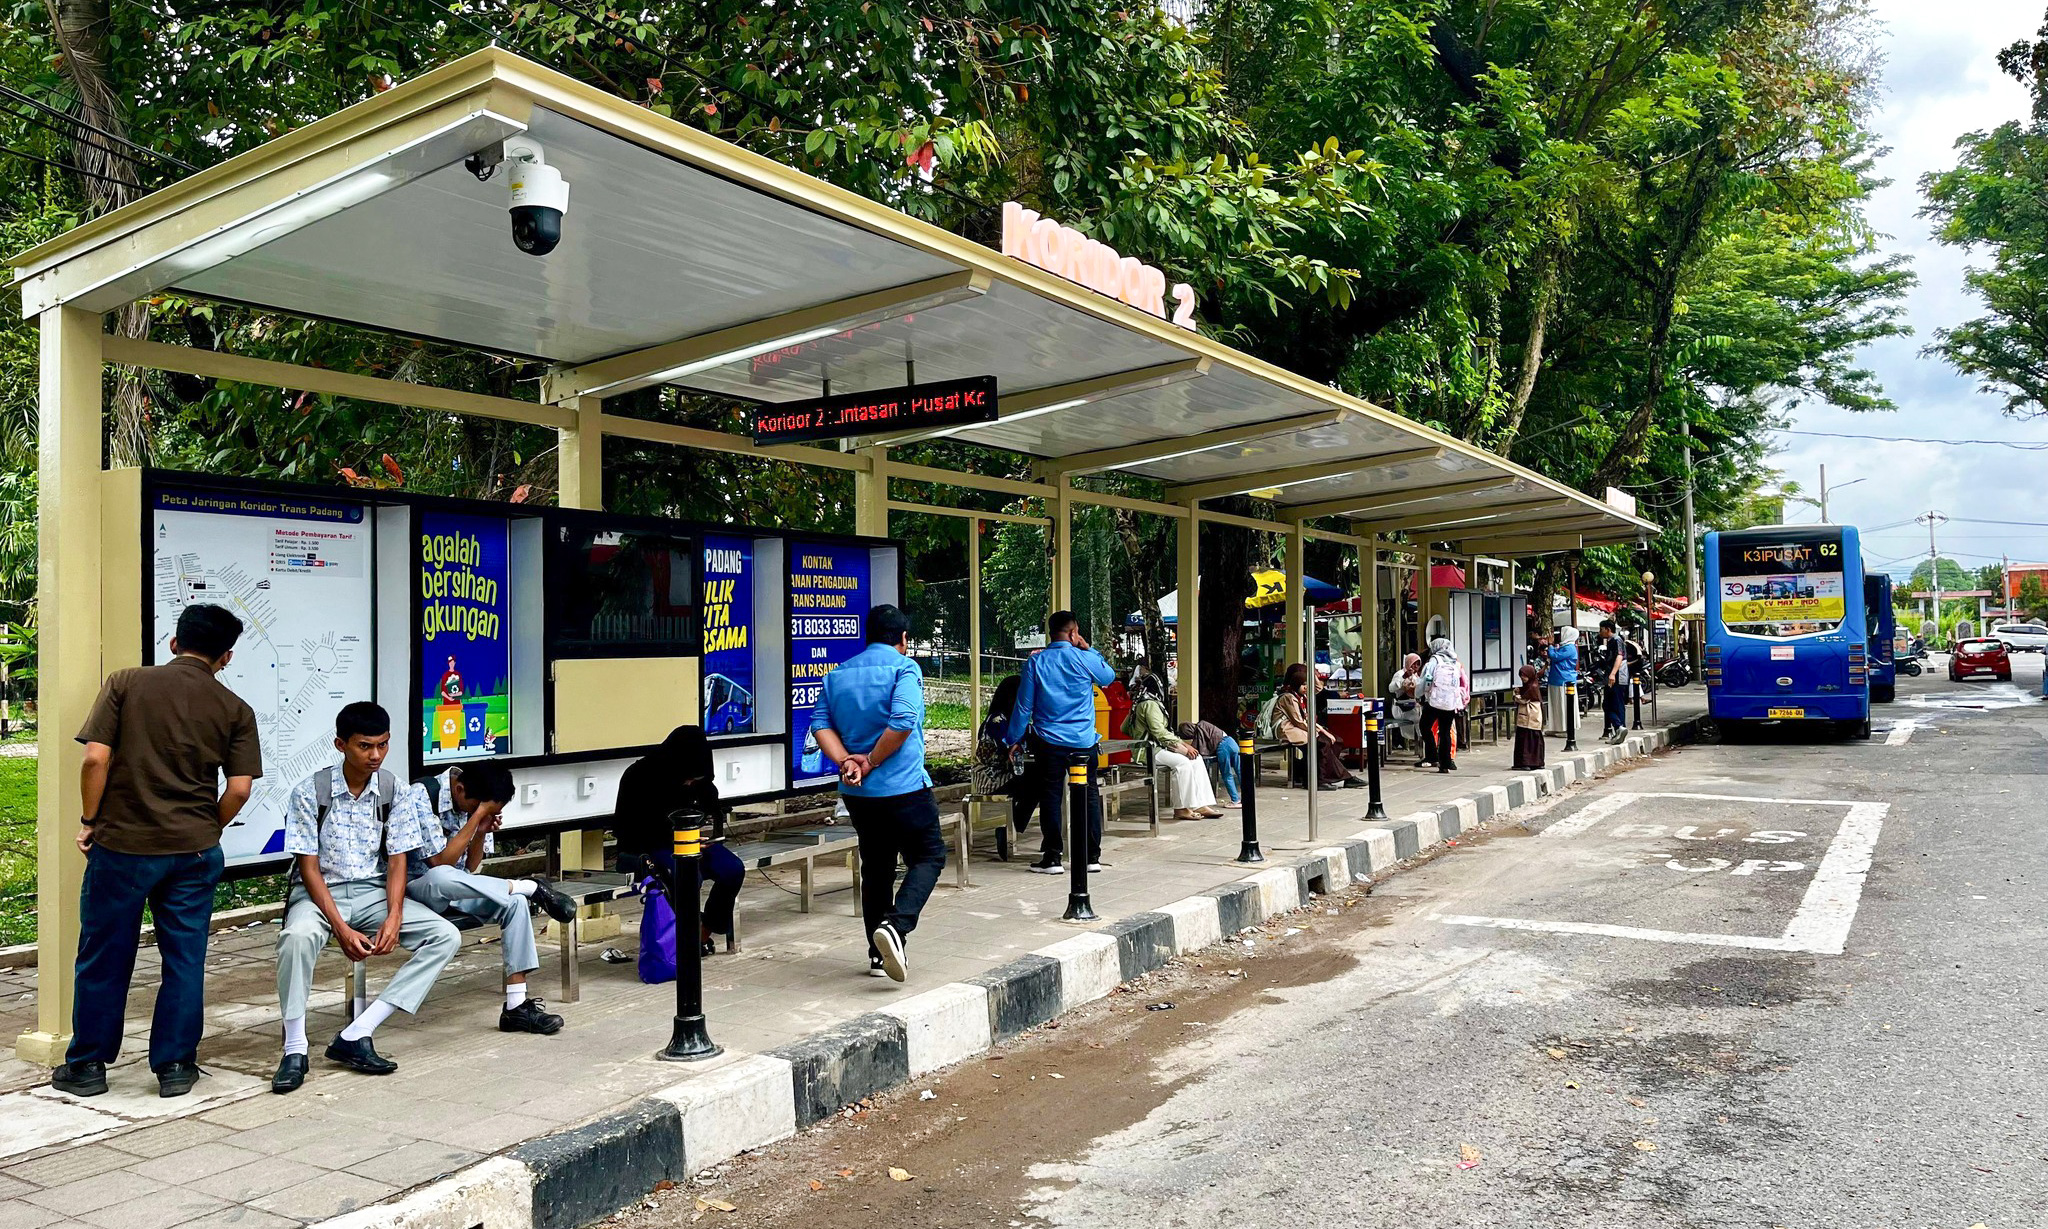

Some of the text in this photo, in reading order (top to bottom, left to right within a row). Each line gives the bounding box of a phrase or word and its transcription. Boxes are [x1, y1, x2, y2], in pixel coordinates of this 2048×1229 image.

[1002, 201, 1197, 331] KORIDOR 2
[757, 413, 811, 433] Koridor
[162, 494, 343, 518] Peta Jaringan Koridor Trans Padang
[275, 529, 299, 537] Metode
[300, 531, 337, 539] Pembayaran
[422, 530, 480, 569] agalah
[1820, 543, 1838, 556] 62
[705, 548, 742, 574] PADANG
[802, 555, 833, 570] KONTAK
[422, 565, 497, 607] bersihan
[812, 575, 858, 590] PENGADUAN
[1725, 582, 1745, 596] 30
[703, 579, 735, 604] ILIK
[816, 594, 847, 608] PADANG
[1800, 598, 1819, 606] INDO
[791, 618, 857, 635] 31 8033 3559
[811, 647, 827, 658] DAN
[791, 664, 807, 678] TAK
[791, 687, 806, 705] 23
[1608, 824, 1807, 844] BUS
